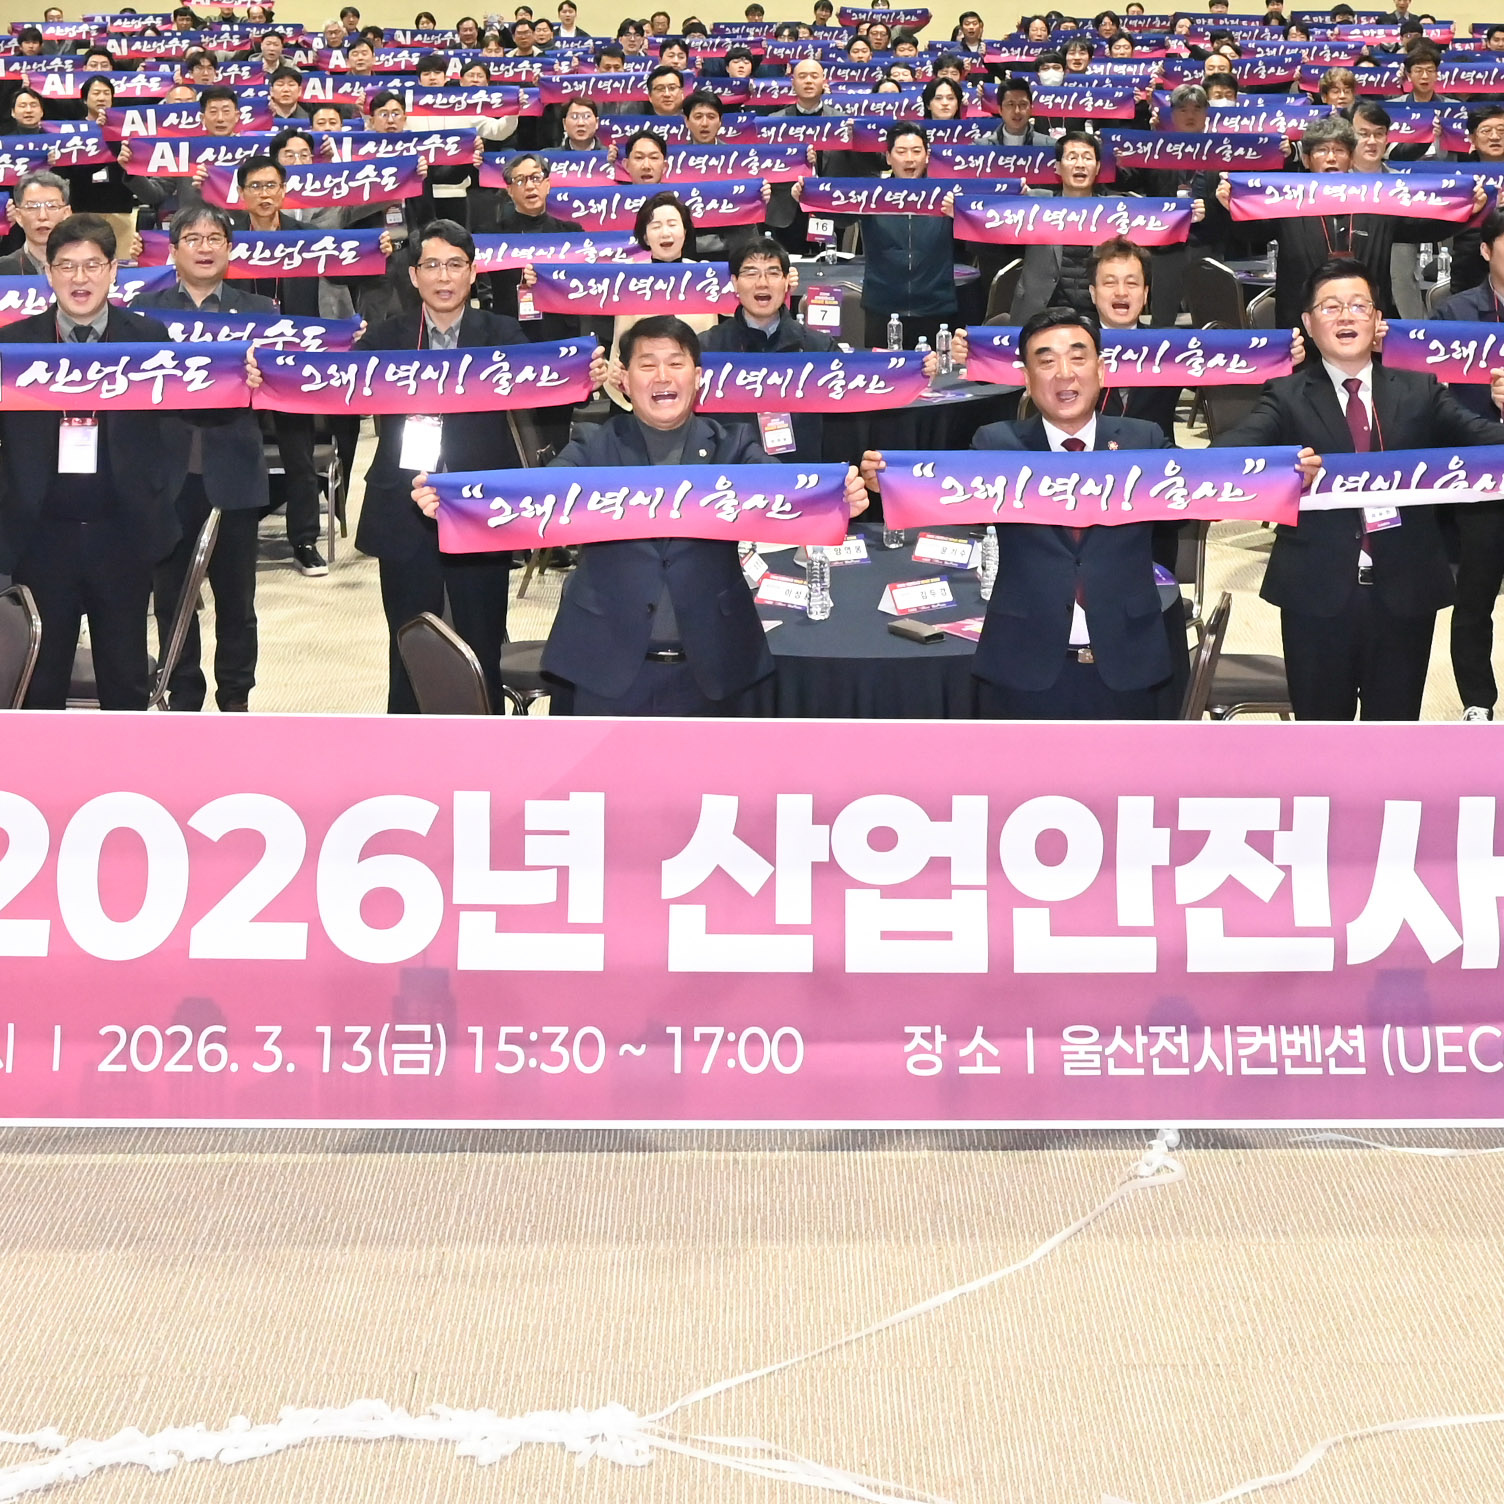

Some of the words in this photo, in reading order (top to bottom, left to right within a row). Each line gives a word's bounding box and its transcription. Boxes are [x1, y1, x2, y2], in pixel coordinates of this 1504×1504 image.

[106, 38, 128, 56] AI
[394, 30, 411, 45] AI
[40, 73, 75, 96] AI
[303, 77, 334, 100] AI
[418, 89, 503, 114] 산업수도
[121, 108, 157, 137] AI
[147, 141, 189, 173] AI
[358, 134, 461, 166] 산업수도
[688, 150, 739, 174] 역시!
[740, 147, 798, 176] 울산”
[942, 148, 996, 177] “그래!
[1166, 139, 1213, 161] 역시!
[285, 164, 399, 201] 산업수도
[818, 182, 883, 215] “그래!
[1247, 177, 1319, 211] “그래!
[1321, 180, 1396, 204] 역시!
[1391, 178, 1456, 207] 울산”
[556, 192, 621, 225] “그래!
[970, 200, 1041, 237] “그래!
[1042, 204, 1103, 233] 역시!
[1106, 201, 1177, 235] 울산”
[814, 221, 829, 233] 16
[228, 235, 360, 274] 산업수도
[552, 269, 626, 308] “그래!
[628, 270, 690, 301] 역시!
[819, 309, 829, 322] 7
[1174, 336, 1268, 378] 울산”
[1409, 328, 1492, 376] “그래!
[15, 349, 215, 405] 산업수도
[276, 355, 378, 405] “그래!
[384, 353, 473, 395] 역시!
[479, 345, 578, 396] 울산”
[735, 362, 814, 398] 역시!
[817, 357, 906, 400] 울산”
[912, 461, 1032, 516] “그래!
[1037, 464, 1142, 512] 역시!
[1149, 458, 1266, 510] 울산”
[461, 482, 582, 538] “그래!
[588, 479, 692, 521] 역시!
[699, 473, 819, 523] 울산”
[97, 1024, 239, 1073] 2026.
[315, 1023, 447, 1077] 13(금)
[467, 1026, 606, 1074] 15:30
[666, 1026, 805, 1075] 17:00
